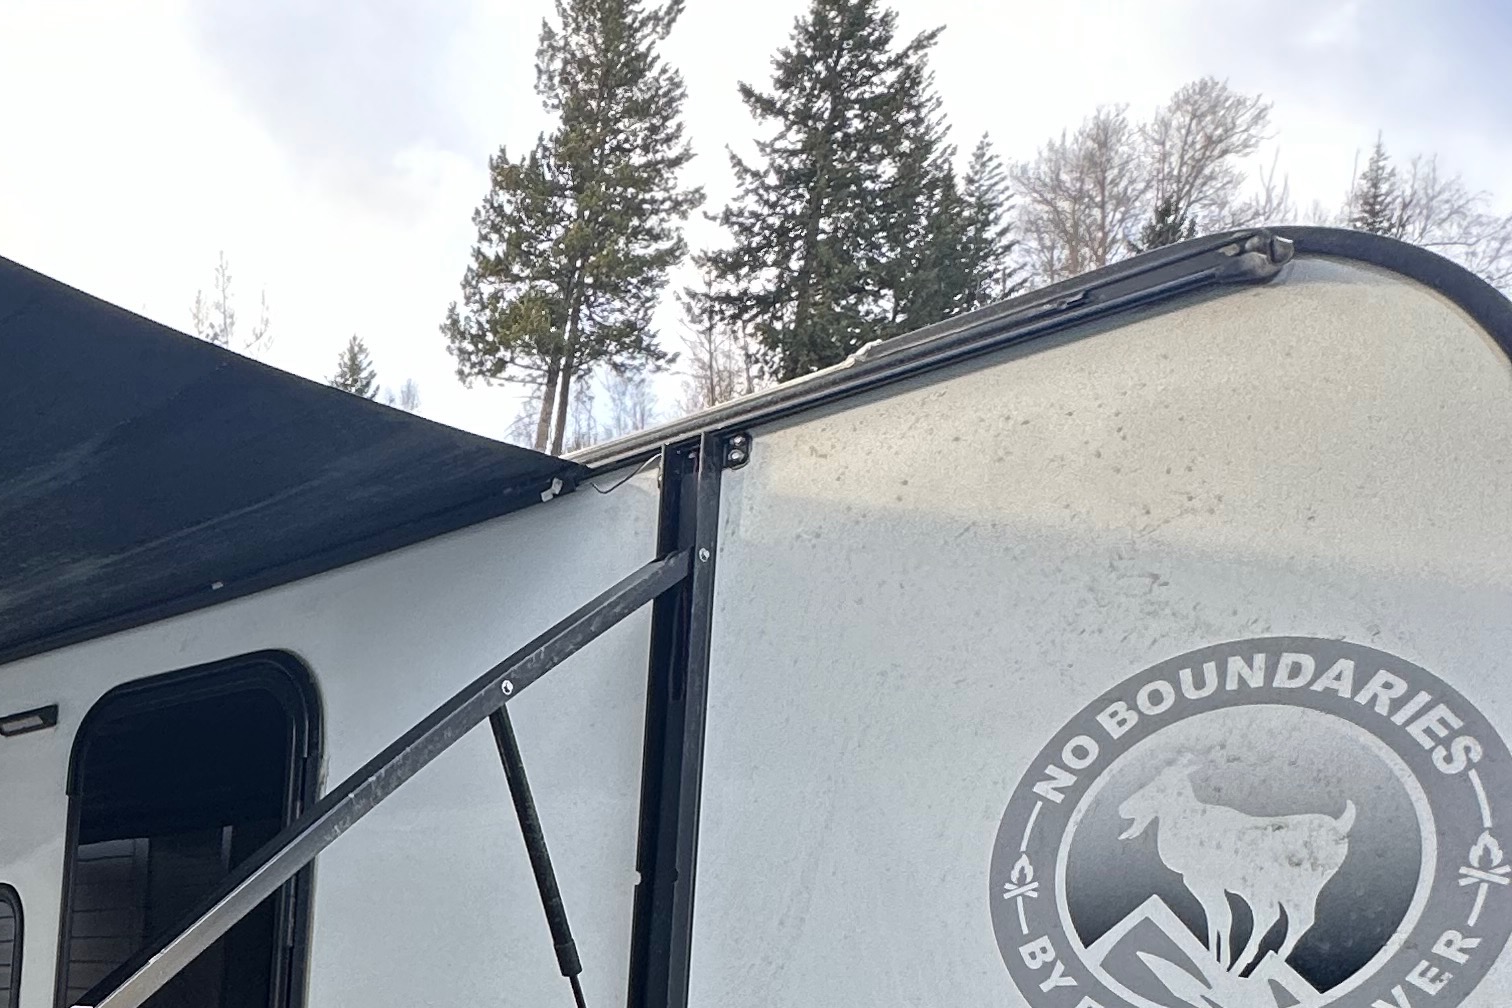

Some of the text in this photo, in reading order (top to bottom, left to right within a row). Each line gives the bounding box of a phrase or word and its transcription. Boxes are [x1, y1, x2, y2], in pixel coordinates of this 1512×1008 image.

[1032, 652, 1483, 804] NO BOUNDARIES
[1018, 935, 1077, 993] BY
